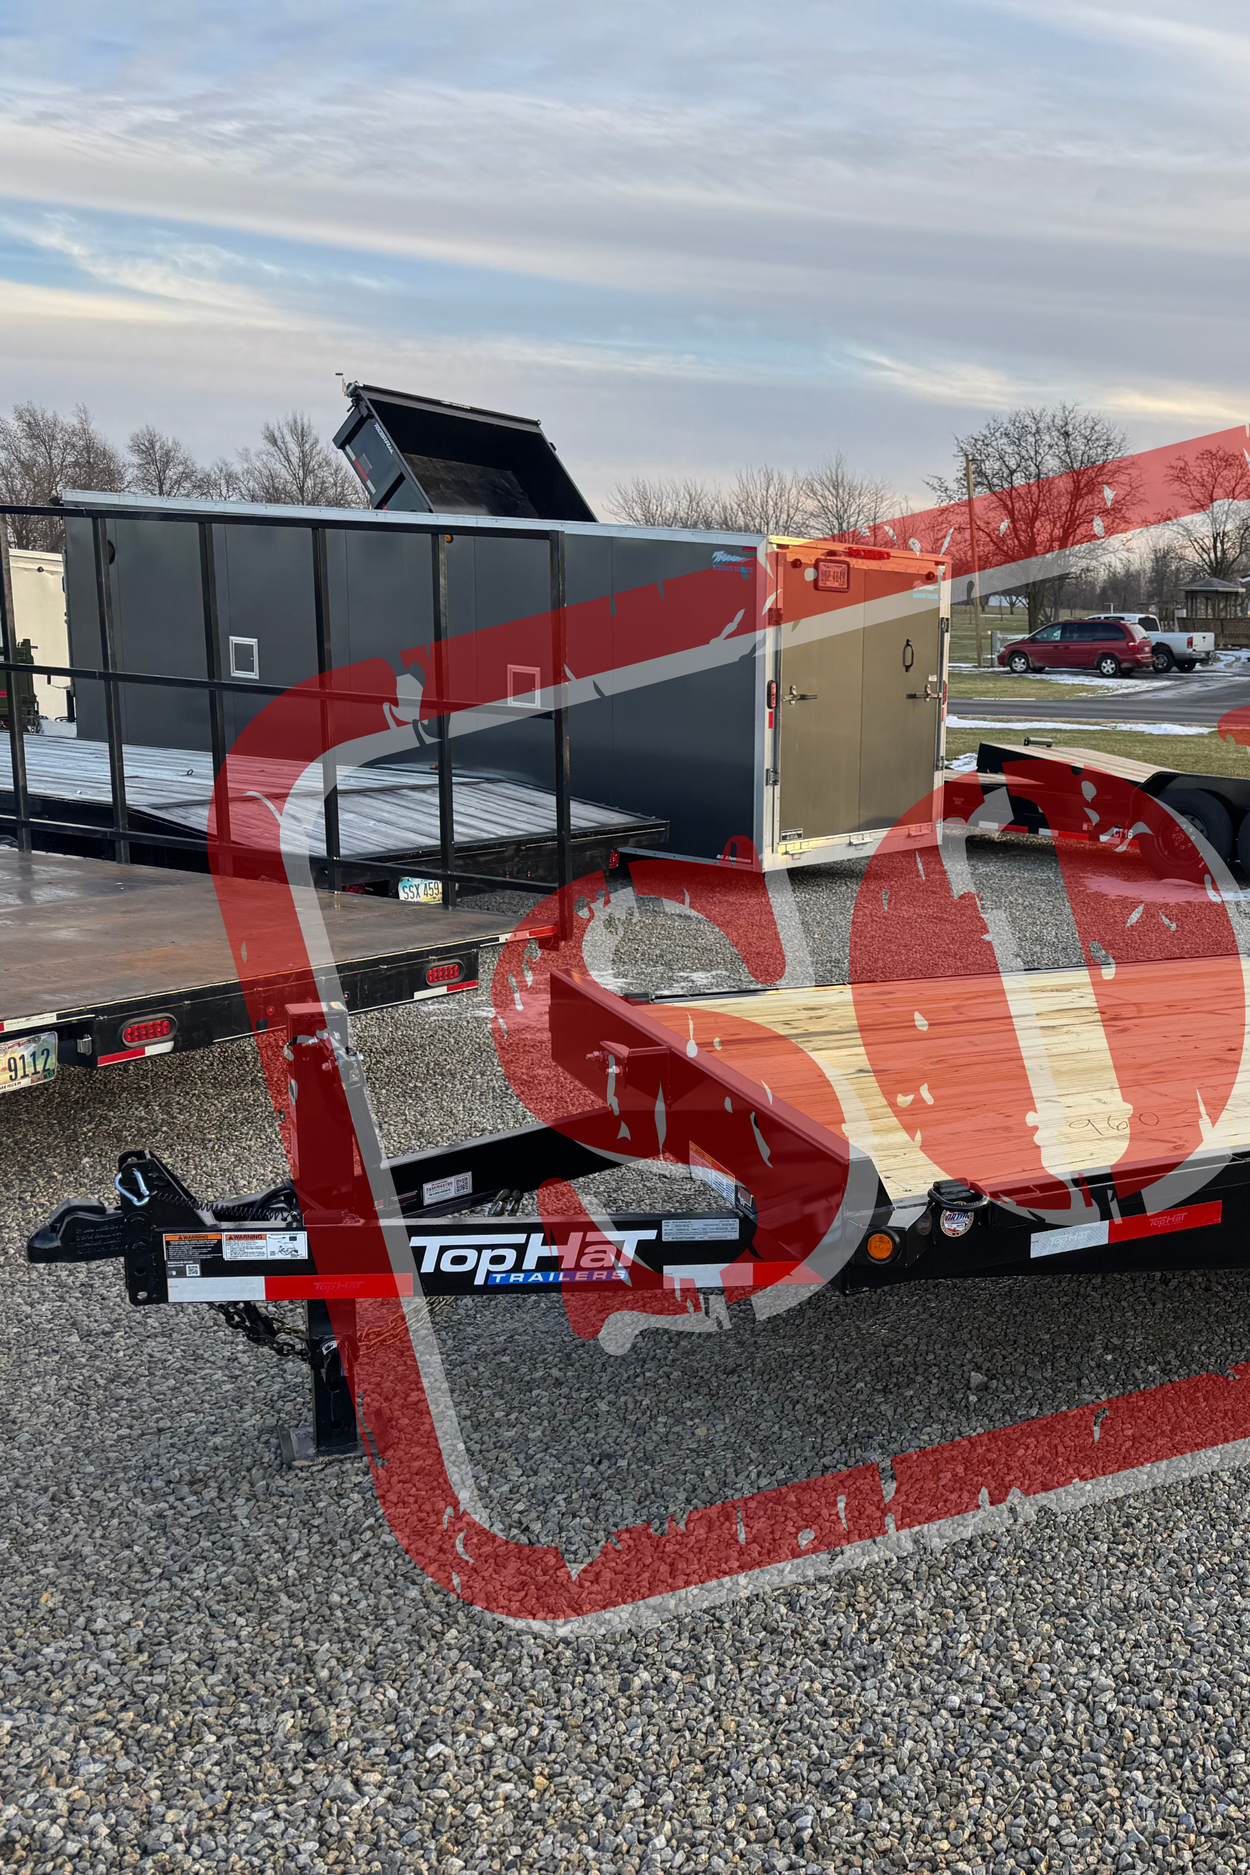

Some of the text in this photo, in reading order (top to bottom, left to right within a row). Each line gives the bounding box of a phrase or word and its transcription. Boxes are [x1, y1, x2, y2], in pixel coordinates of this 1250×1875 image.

[1113, 828, 1134, 839] CT16
[402, 881, 443, 900] SSX 459
[7, 1048, 51, 1082] 9112
[492, 1269, 627, 1283] TRAILERS
